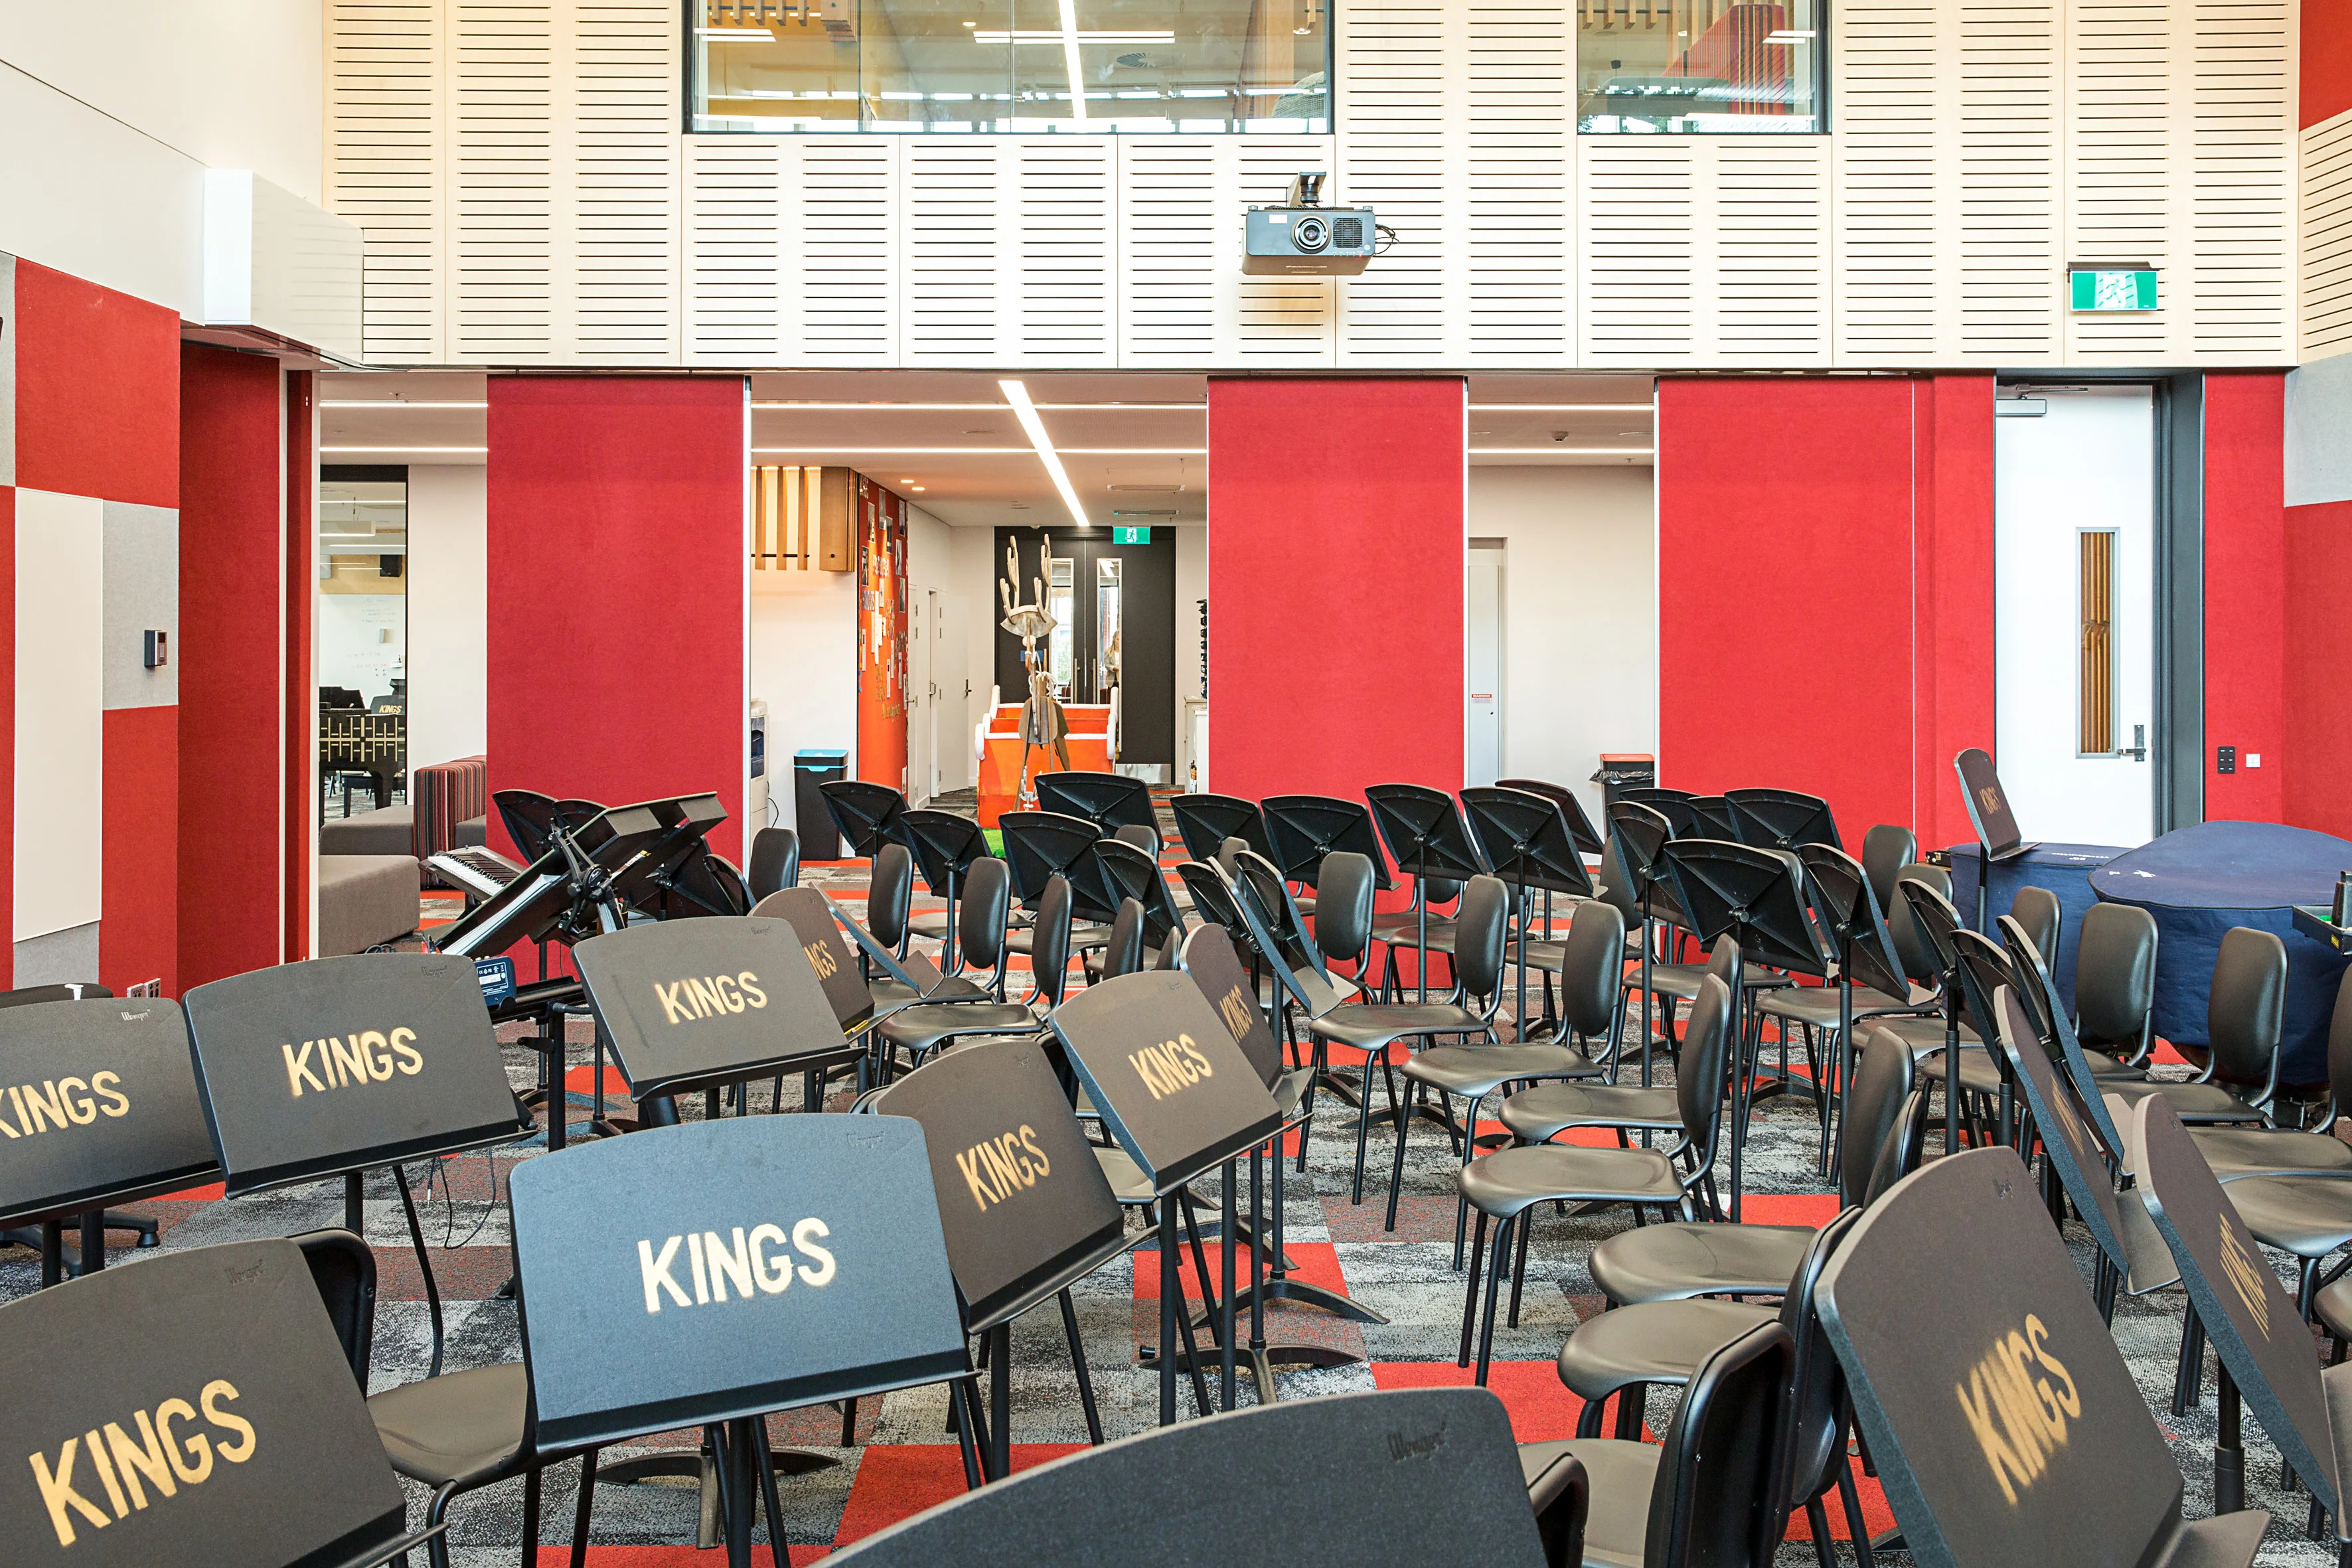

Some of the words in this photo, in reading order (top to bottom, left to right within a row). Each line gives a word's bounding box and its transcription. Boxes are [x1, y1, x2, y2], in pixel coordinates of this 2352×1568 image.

[378, 704, 402, 714] KINGS
[803, 939, 837, 981] NGS
[653, 971, 767, 1025] KINGS
[1219, 984, 1253, 1044] KINGS
[282, 1027, 424, 1097] KINGS
[1127, 1032, 1214, 1101] KINGS
[955, 1125, 1050, 1212] KINGS
[637, 1217, 836, 1312] KINGS
[1955, 1313, 2081, 1507] KINGS
[29, 1379, 256, 1547] KINGS
